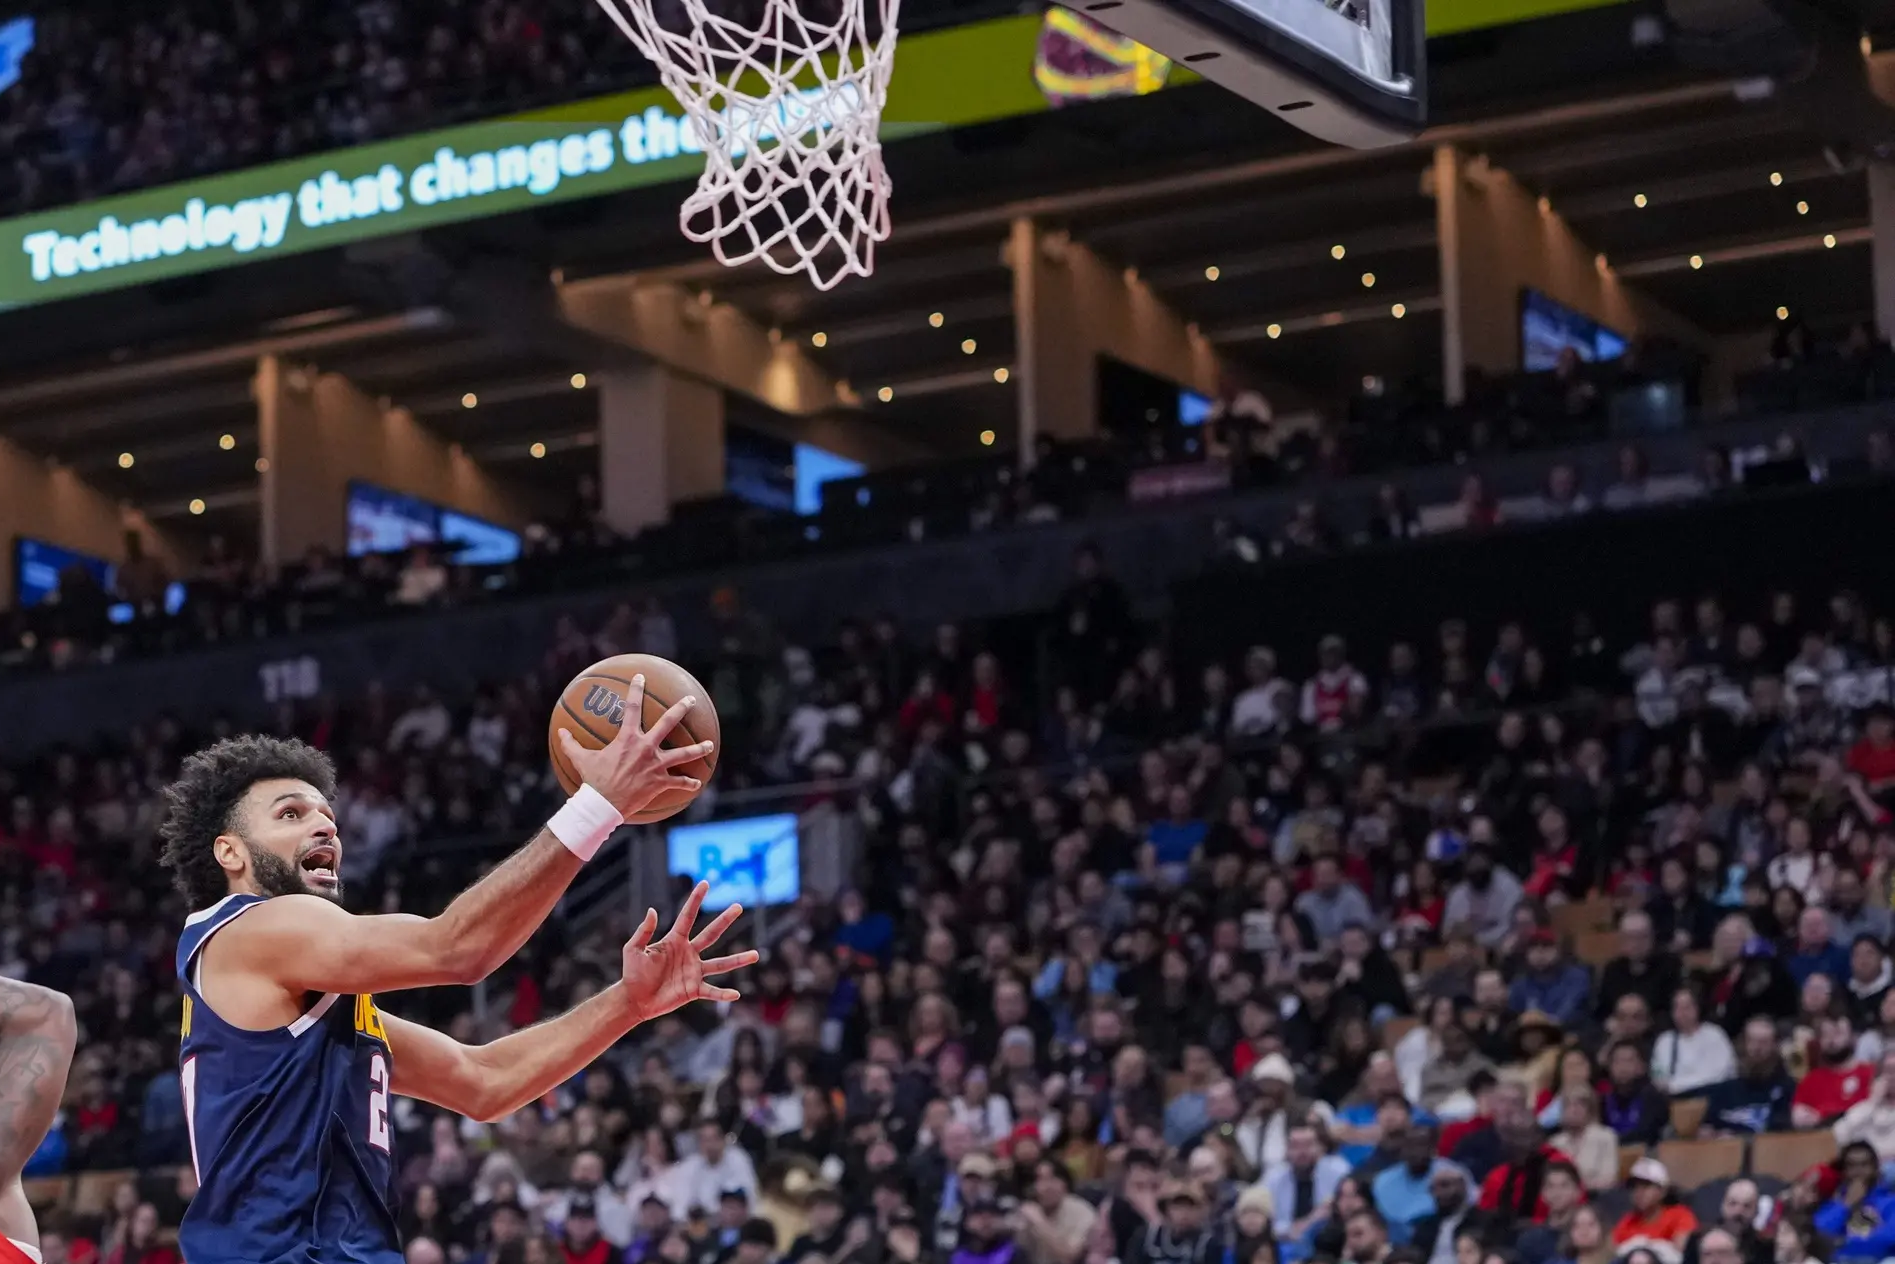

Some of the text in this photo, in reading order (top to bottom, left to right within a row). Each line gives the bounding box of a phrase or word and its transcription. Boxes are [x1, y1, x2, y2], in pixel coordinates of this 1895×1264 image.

[22, 191, 294, 282] Technology
[297, 164, 404, 227] that
[409, 132, 615, 206] changes
